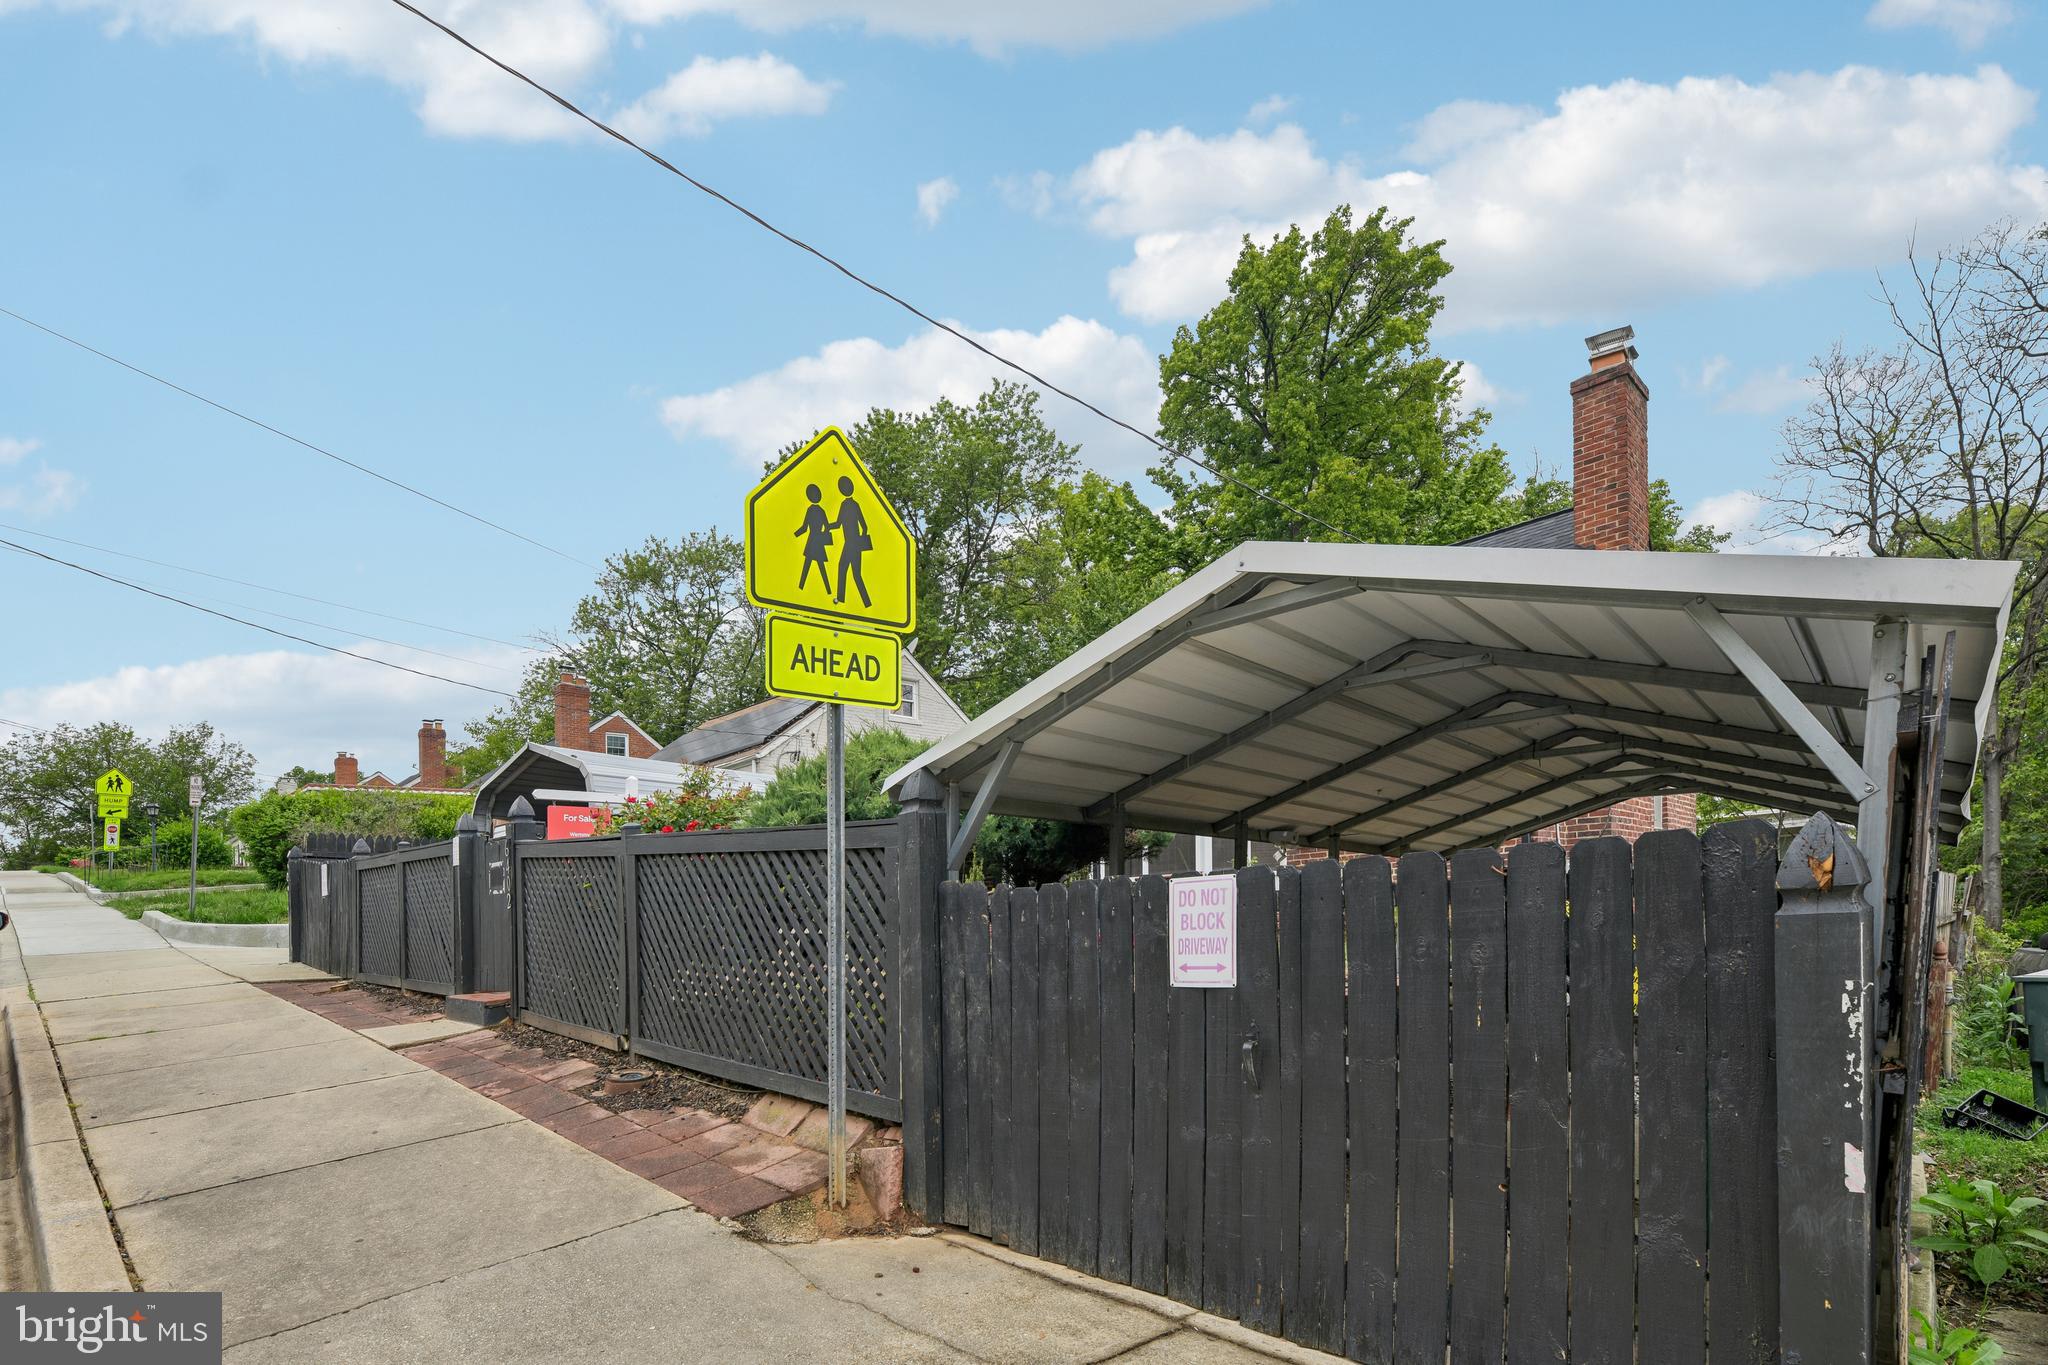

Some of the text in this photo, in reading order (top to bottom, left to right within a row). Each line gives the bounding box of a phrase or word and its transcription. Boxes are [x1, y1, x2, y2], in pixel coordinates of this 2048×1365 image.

[790, 643, 881, 682] AHEAD
[563, 814, 577, 822] For
[1178, 887, 1228, 907] DO NOT
[1181, 912, 1225, 931] BLOCK
[1178, 937, 1228, 956] DRIVEWAY
